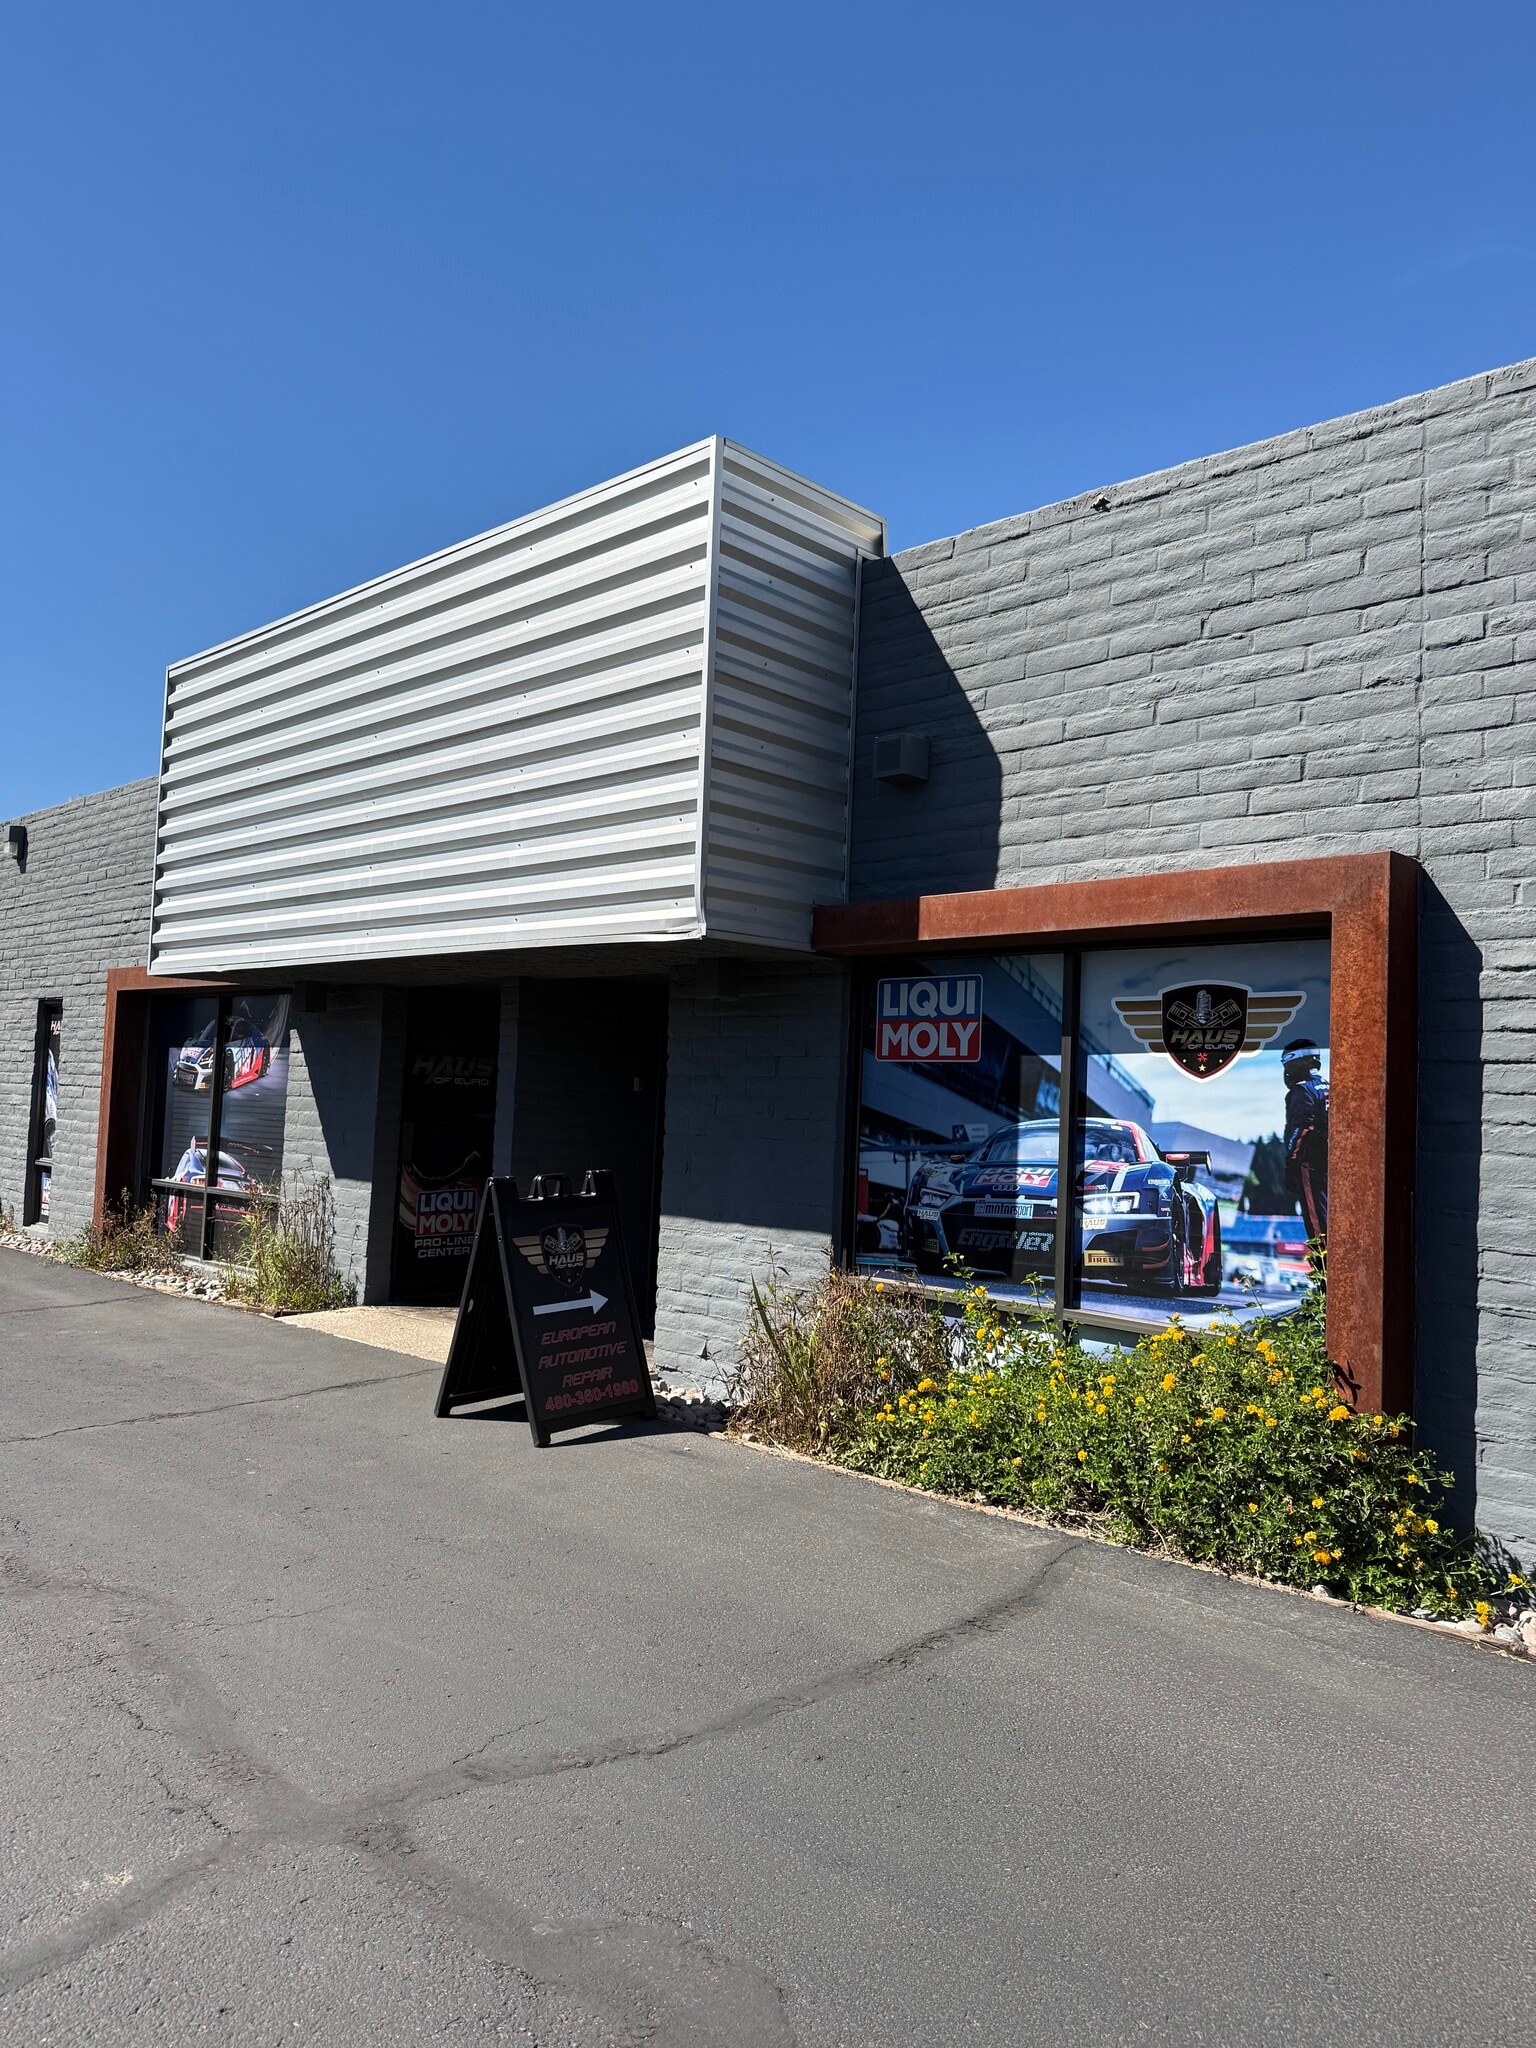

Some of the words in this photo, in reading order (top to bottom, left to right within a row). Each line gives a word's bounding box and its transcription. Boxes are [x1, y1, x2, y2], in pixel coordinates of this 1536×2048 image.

[883, 980, 976, 1018] LIQUI
[881, 1022, 979, 1057] MOLY
[1170, 1029, 1240, 1049] HAUS
[411, 1056, 496, 1085] HAUS
[976, 1174, 1051, 1185] MOLY
[420, 1191, 474, 1213] LIQUI
[418, 1212, 475, 1234] MOLY
[415, 1236, 475, 1248] PRO-LINE
[418, 1246, 470, 1259] CENTER
[547, 1252, 584, 1269] HAUS
[1087, 1253, 1122, 1264] PIRELLI
[541, 1320, 617, 1346] EUROPEAN
[537, 1340, 628, 1370] AUTOMOTIVE
[562, 1366, 613, 1389] REPAIR
